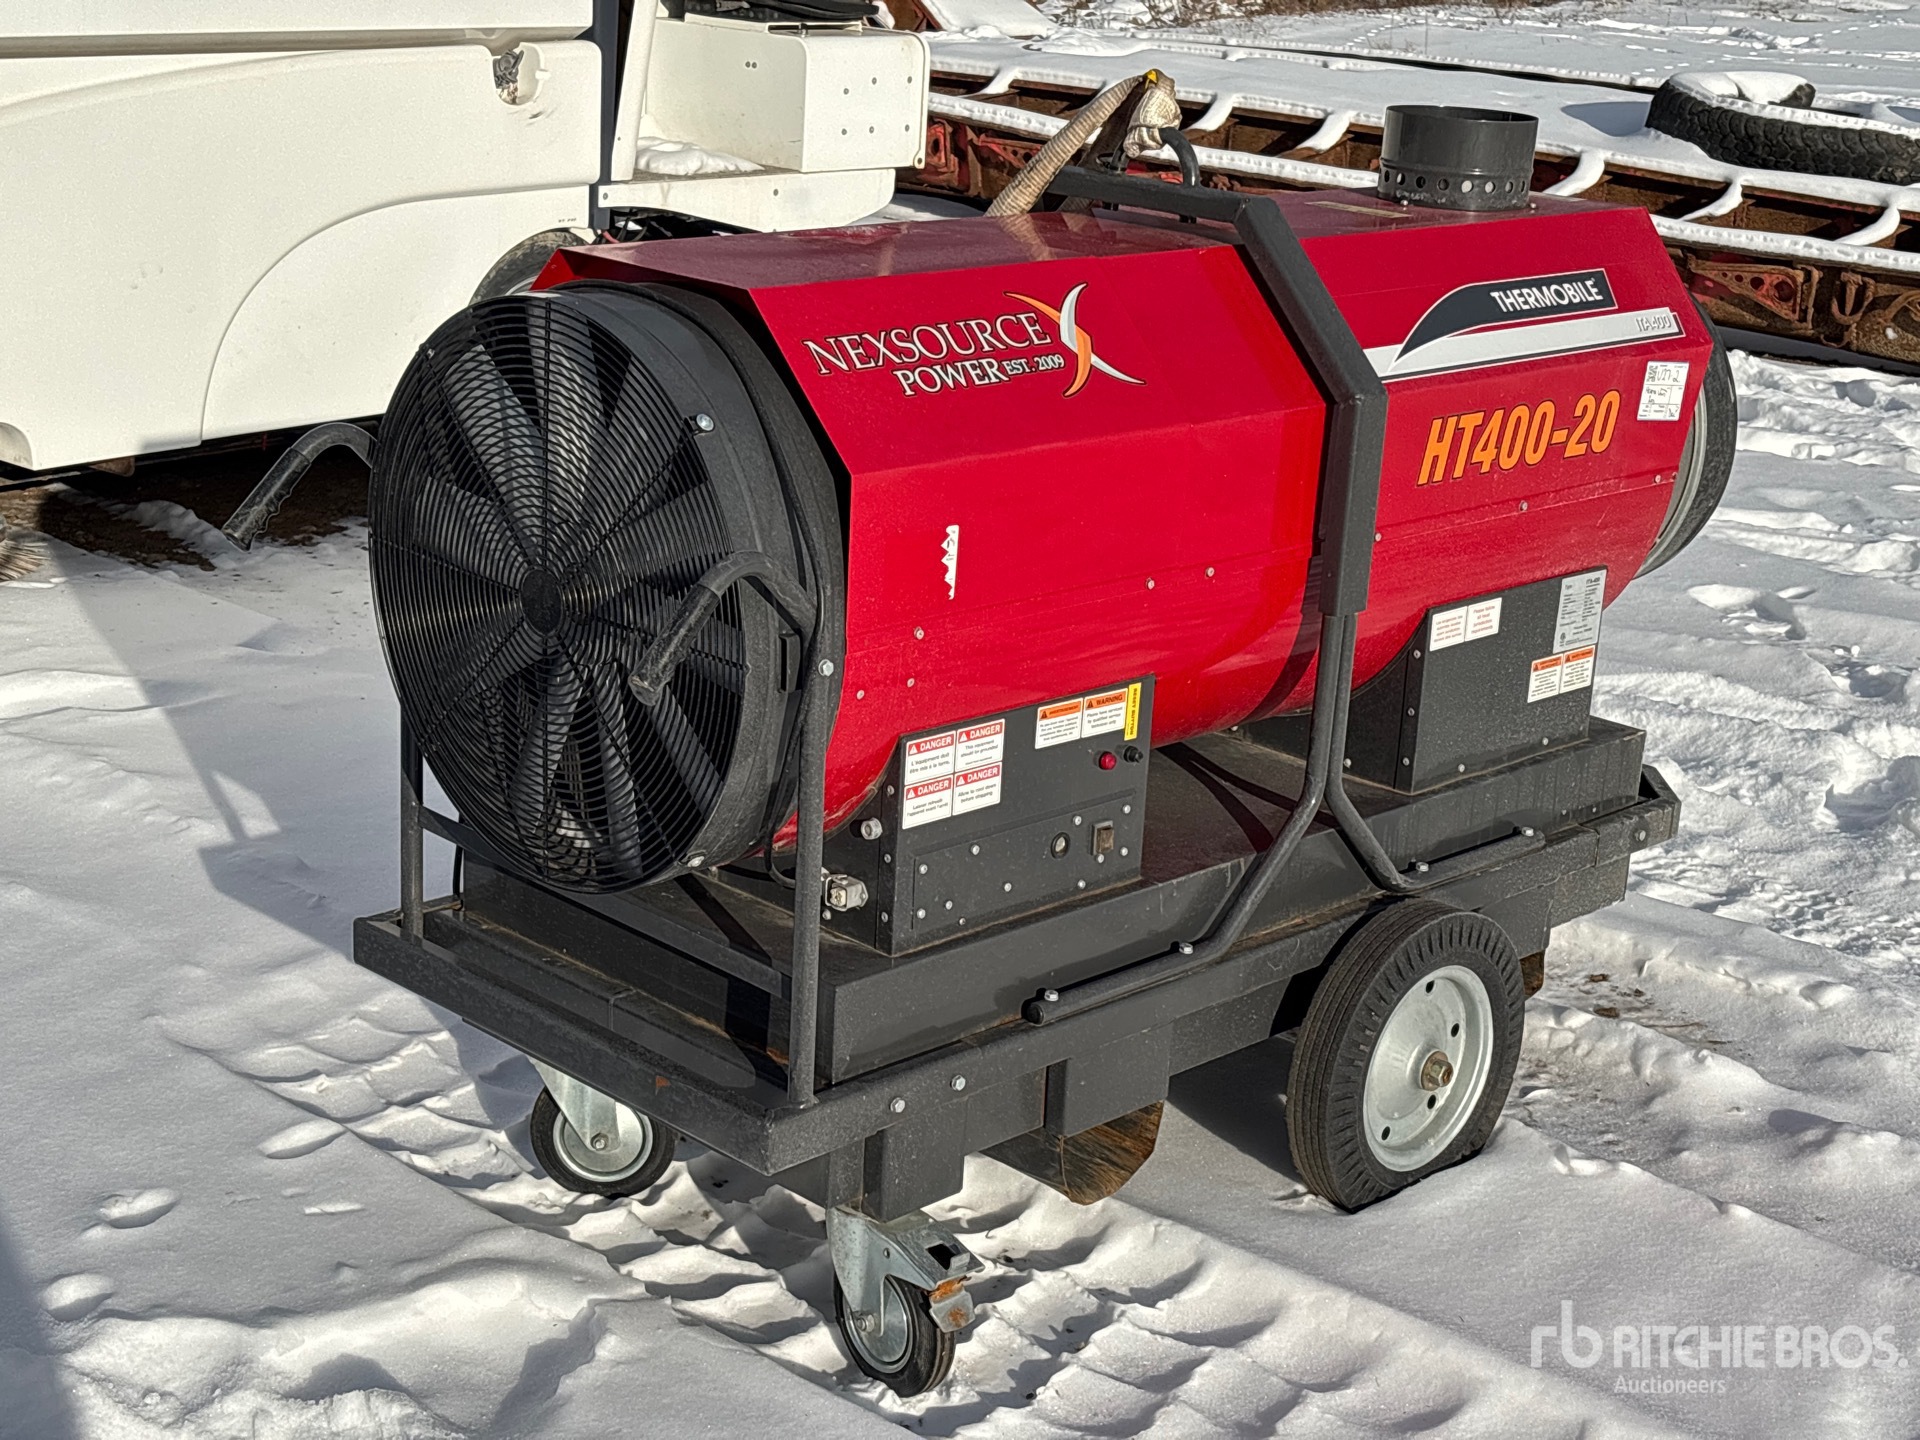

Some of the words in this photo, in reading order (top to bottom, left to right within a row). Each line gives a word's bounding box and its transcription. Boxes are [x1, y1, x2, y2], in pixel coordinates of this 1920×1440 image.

[1490, 278, 1604, 313] THERMOBILE
[803, 312, 1052, 376] NEXSOURCE
[893, 356, 1010, 396] POWER
[1004, 358, 1036, 375] EST.
[1036, 353, 1066, 371] 2009
[1416, 389, 1621, 488] HT400-20
[1096, 694, 1123, 706] WARNING
[970, 724, 1001, 739] DANGER
[920, 736, 952, 752] DANGER
[968, 767, 998, 782] DANGER
[917, 780, 950, 796] DANGER
